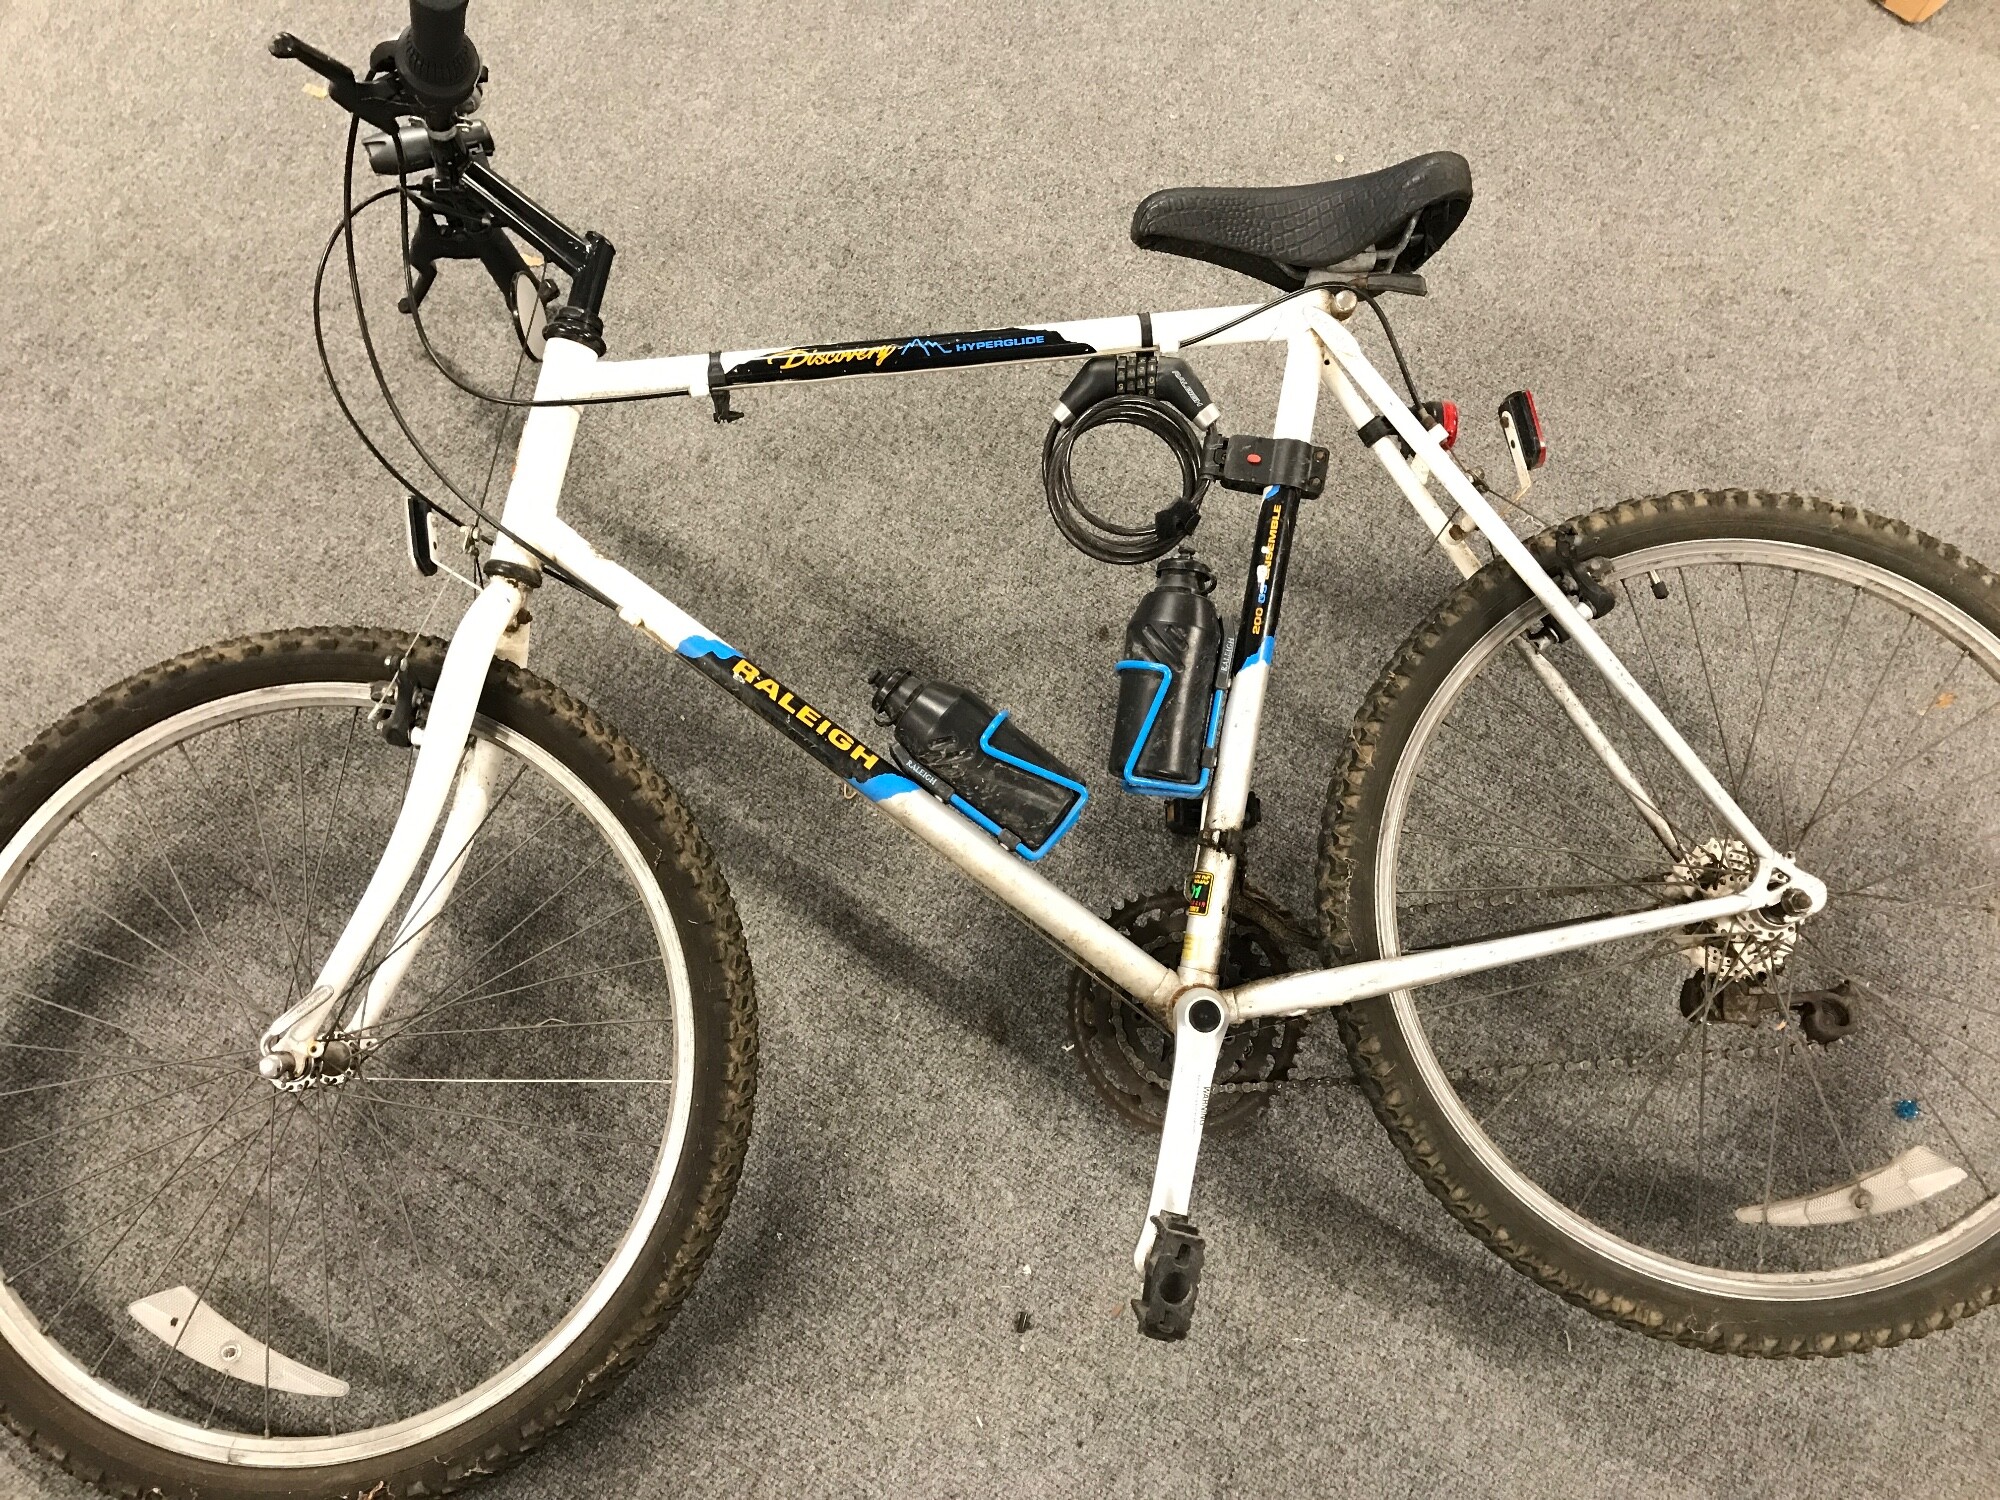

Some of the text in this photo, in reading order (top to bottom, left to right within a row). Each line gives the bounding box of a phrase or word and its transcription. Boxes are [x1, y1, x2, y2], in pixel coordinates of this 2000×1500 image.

[768, 335, 1045, 370] Discovery HYPERGLIDE
[1252, 607, 1264, 635] 200
[1219, 638, 1235, 672] RALEIGH
[732, 658, 879, 770] RALEIGH
[905, 759, 937, 786] RALEIGH
